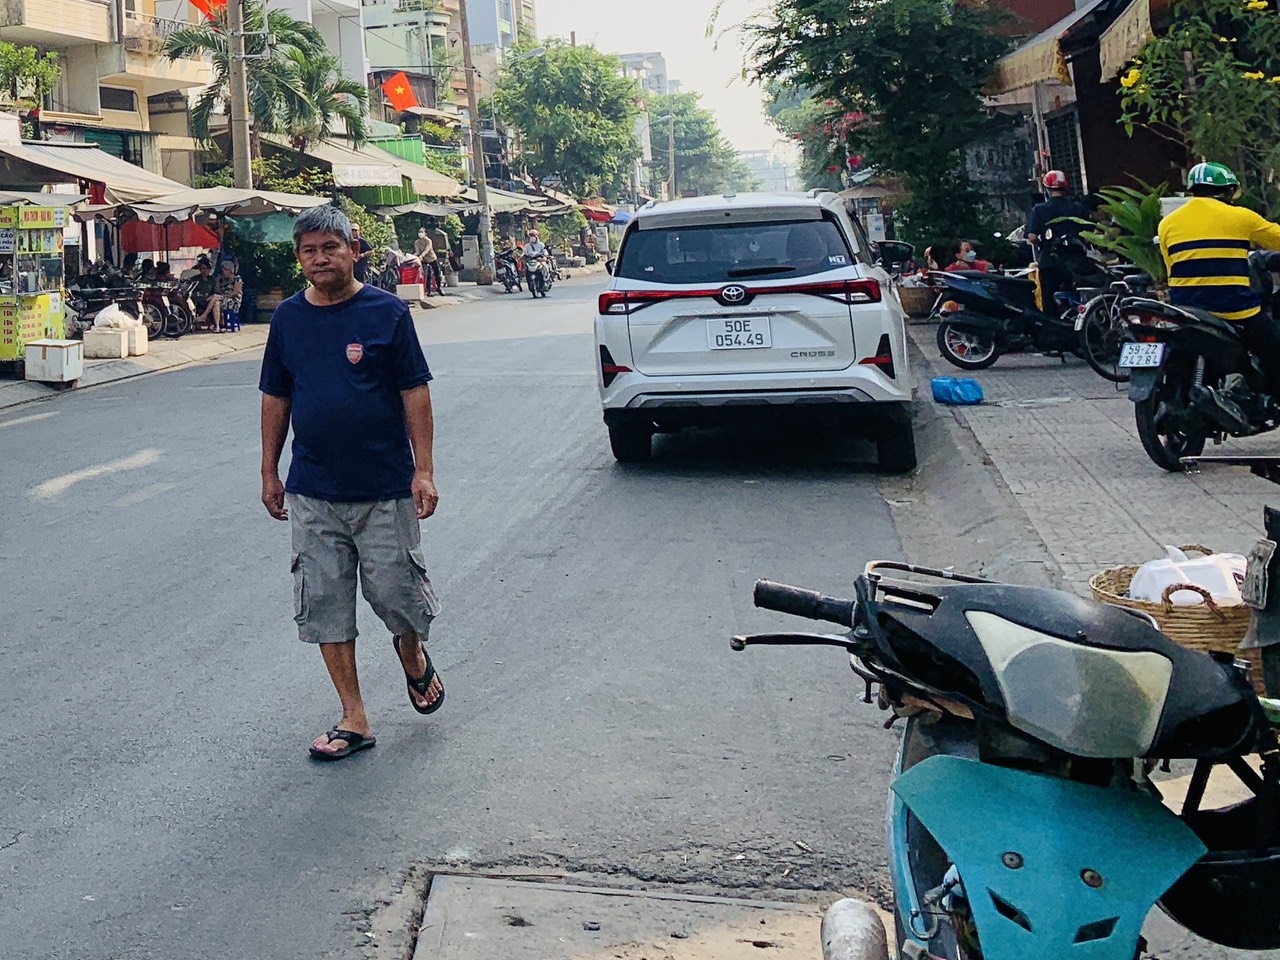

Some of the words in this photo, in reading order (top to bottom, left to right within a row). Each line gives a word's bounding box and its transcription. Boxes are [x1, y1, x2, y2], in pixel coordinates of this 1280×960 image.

[724, 320, 752, 333] 50E
[715, 333, 764, 347] 054.49
[790, 350, 835, 358] CROSS
[1121, 355, 1158, 366] 242.84
